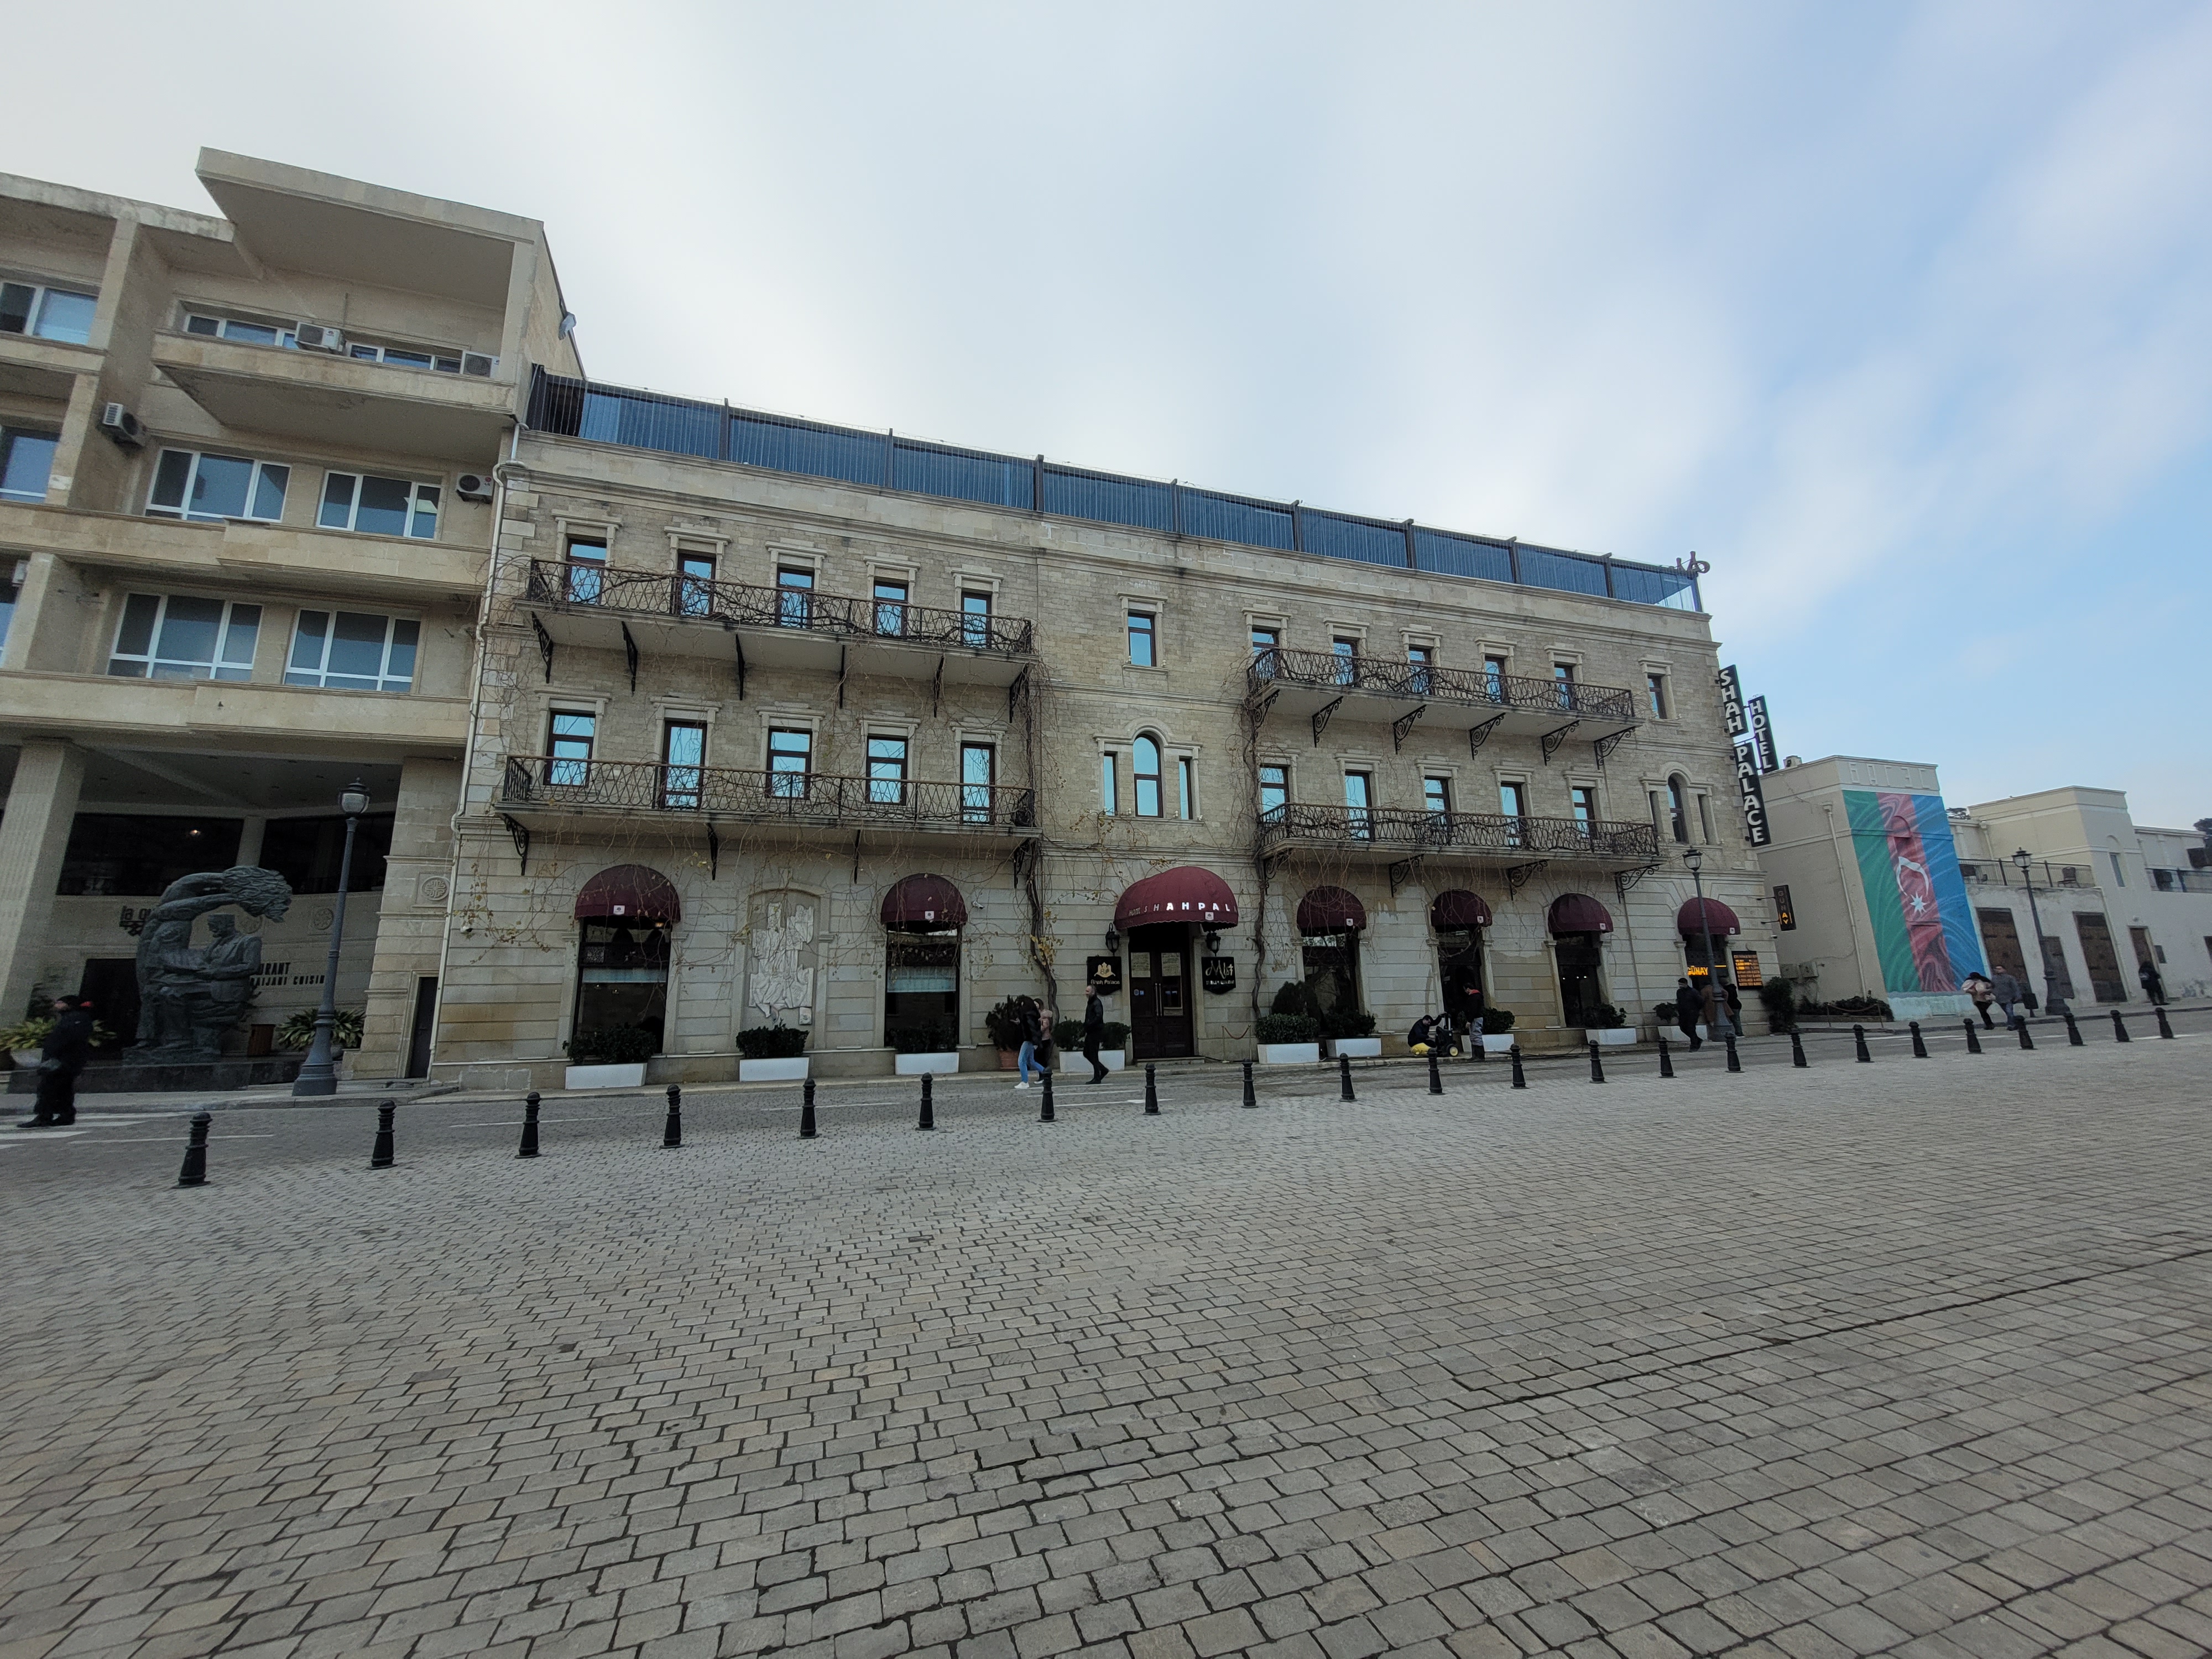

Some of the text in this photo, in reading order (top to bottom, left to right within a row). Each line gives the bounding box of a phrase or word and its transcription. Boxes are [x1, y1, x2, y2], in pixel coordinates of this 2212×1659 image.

[1720, 670, 1744, 734] SHAH
[1749, 700, 1772, 770] HOTEL
[1736, 746, 1765, 843] PALACE
